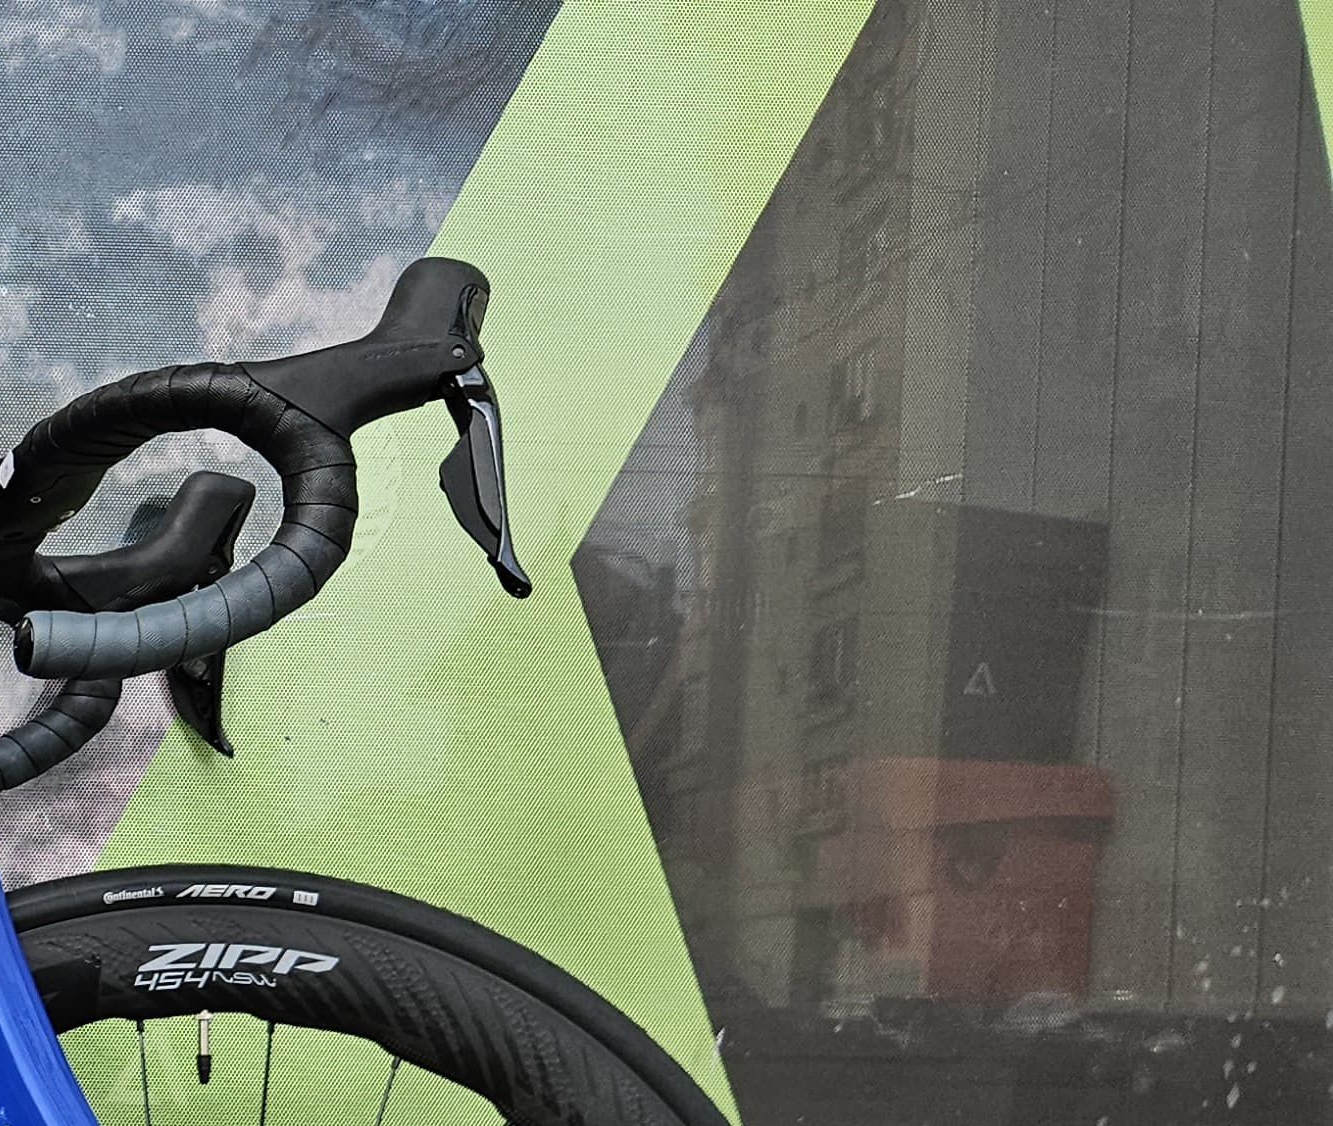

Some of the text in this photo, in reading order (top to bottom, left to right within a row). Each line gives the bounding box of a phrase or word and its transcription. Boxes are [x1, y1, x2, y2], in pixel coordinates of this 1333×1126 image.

[103, 888, 156, 904] Continental
[176, 884, 277, 900] AERO
[136, 943, 340, 975] ZIPP
